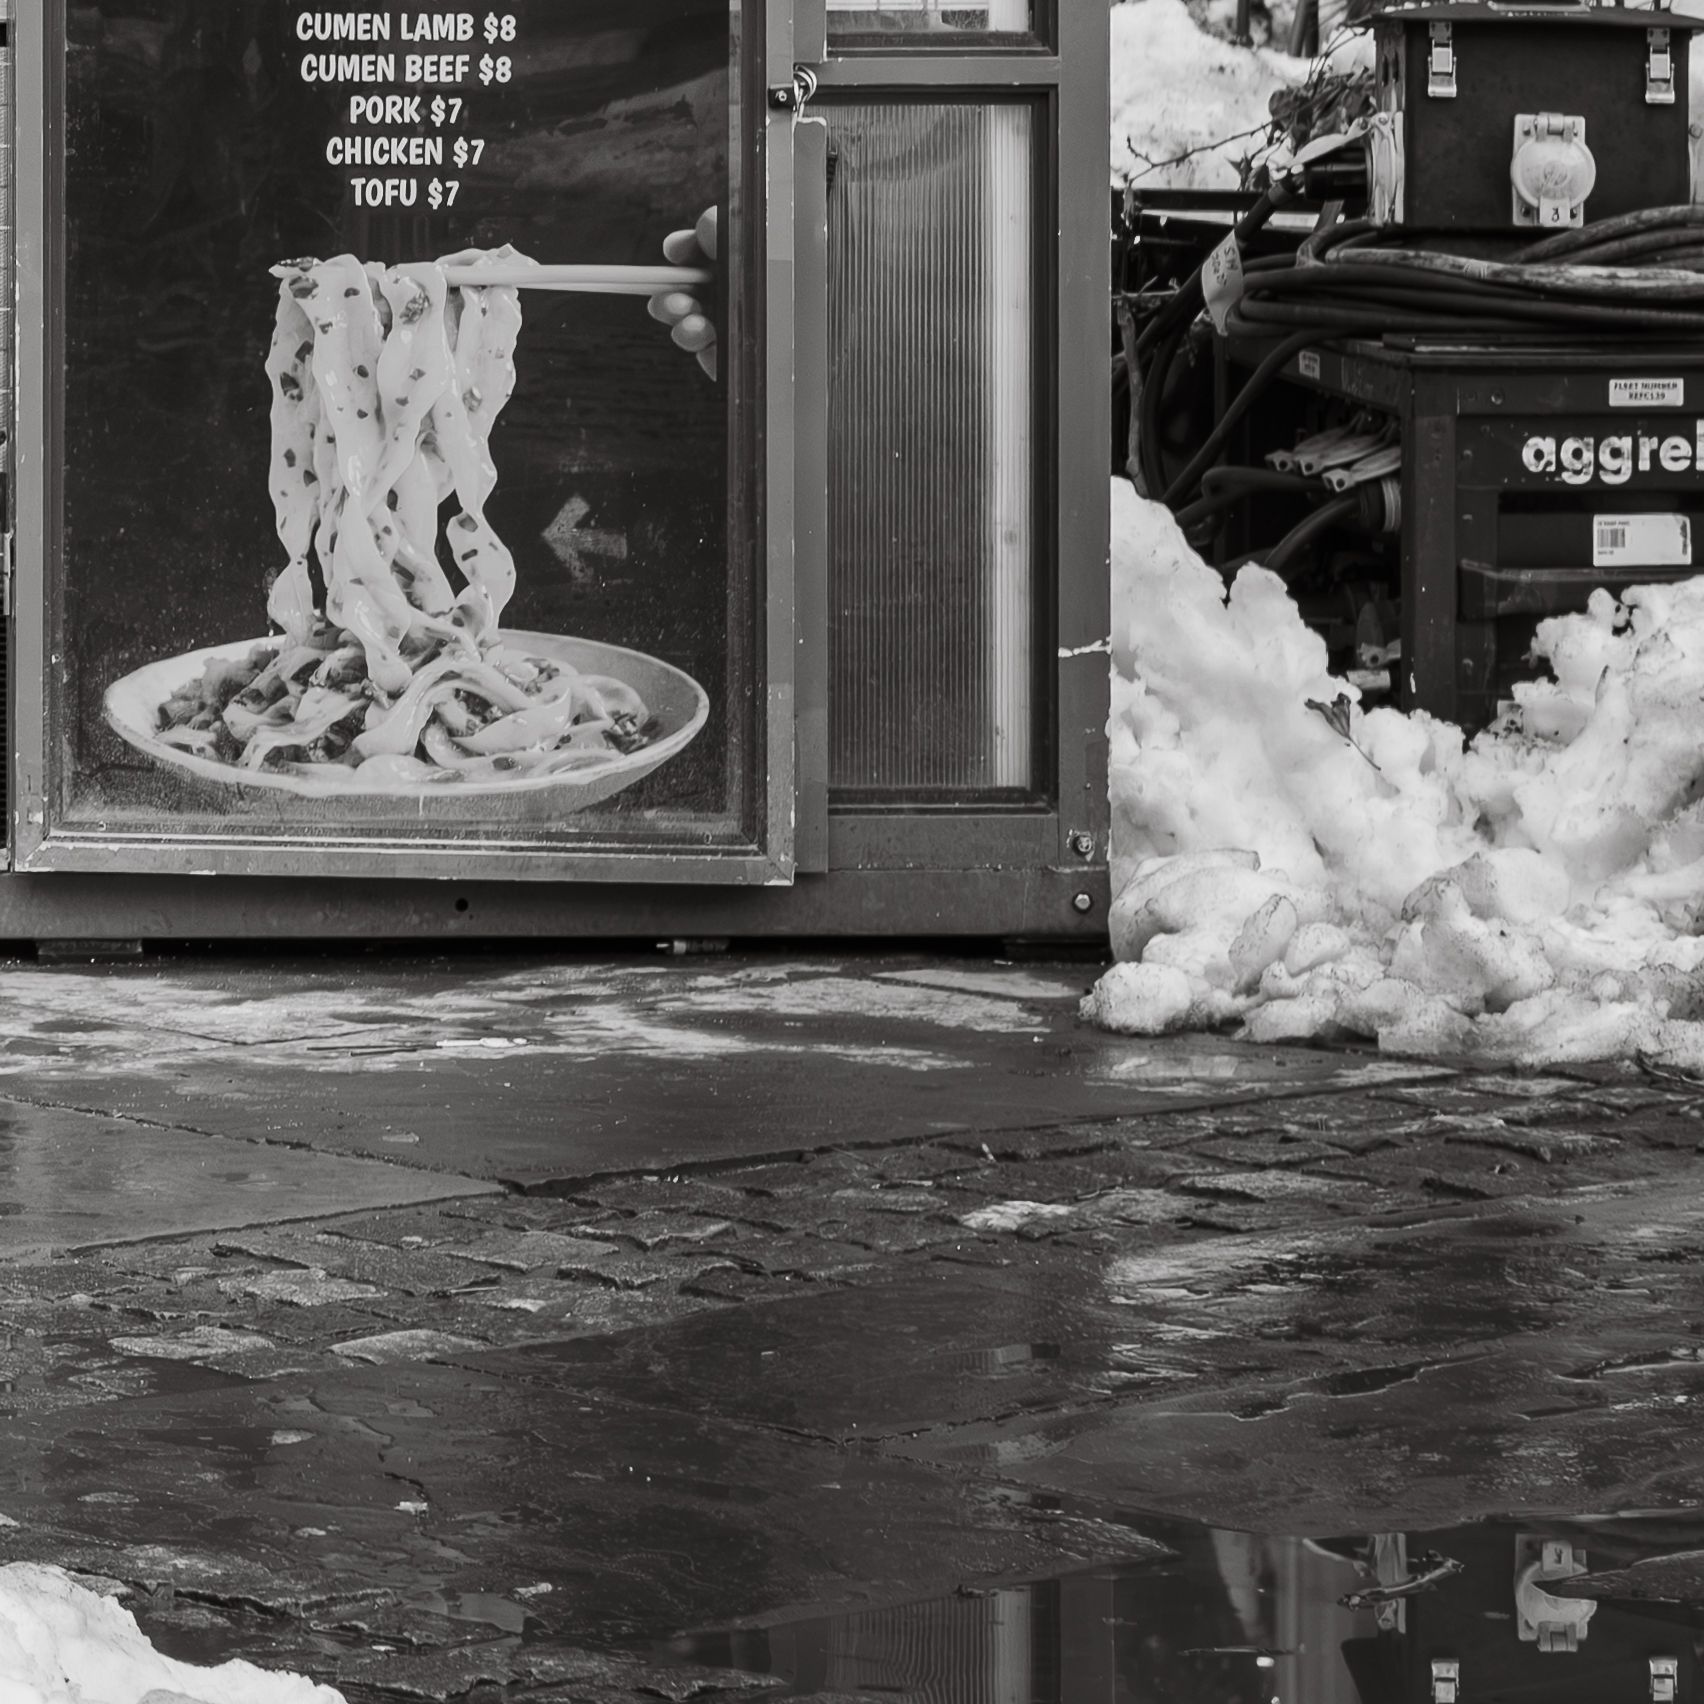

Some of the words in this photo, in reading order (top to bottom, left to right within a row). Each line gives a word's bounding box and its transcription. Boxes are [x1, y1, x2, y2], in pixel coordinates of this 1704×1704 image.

[296, 12, 391, 41] CUMEN
[400, 12, 474, 42] LAMB
[483, 11, 517, 45] $8
[350, 95, 421, 124] PORK
[430, 94, 463, 128] $7
[326, 135, 443, 166] CHICKEN
[452, 136, 485, 169] $7
[350, 177, 418, 207] TOFU
[427, 177, 460, 210] $7
[1522, 419, 1704, 485] aggre
